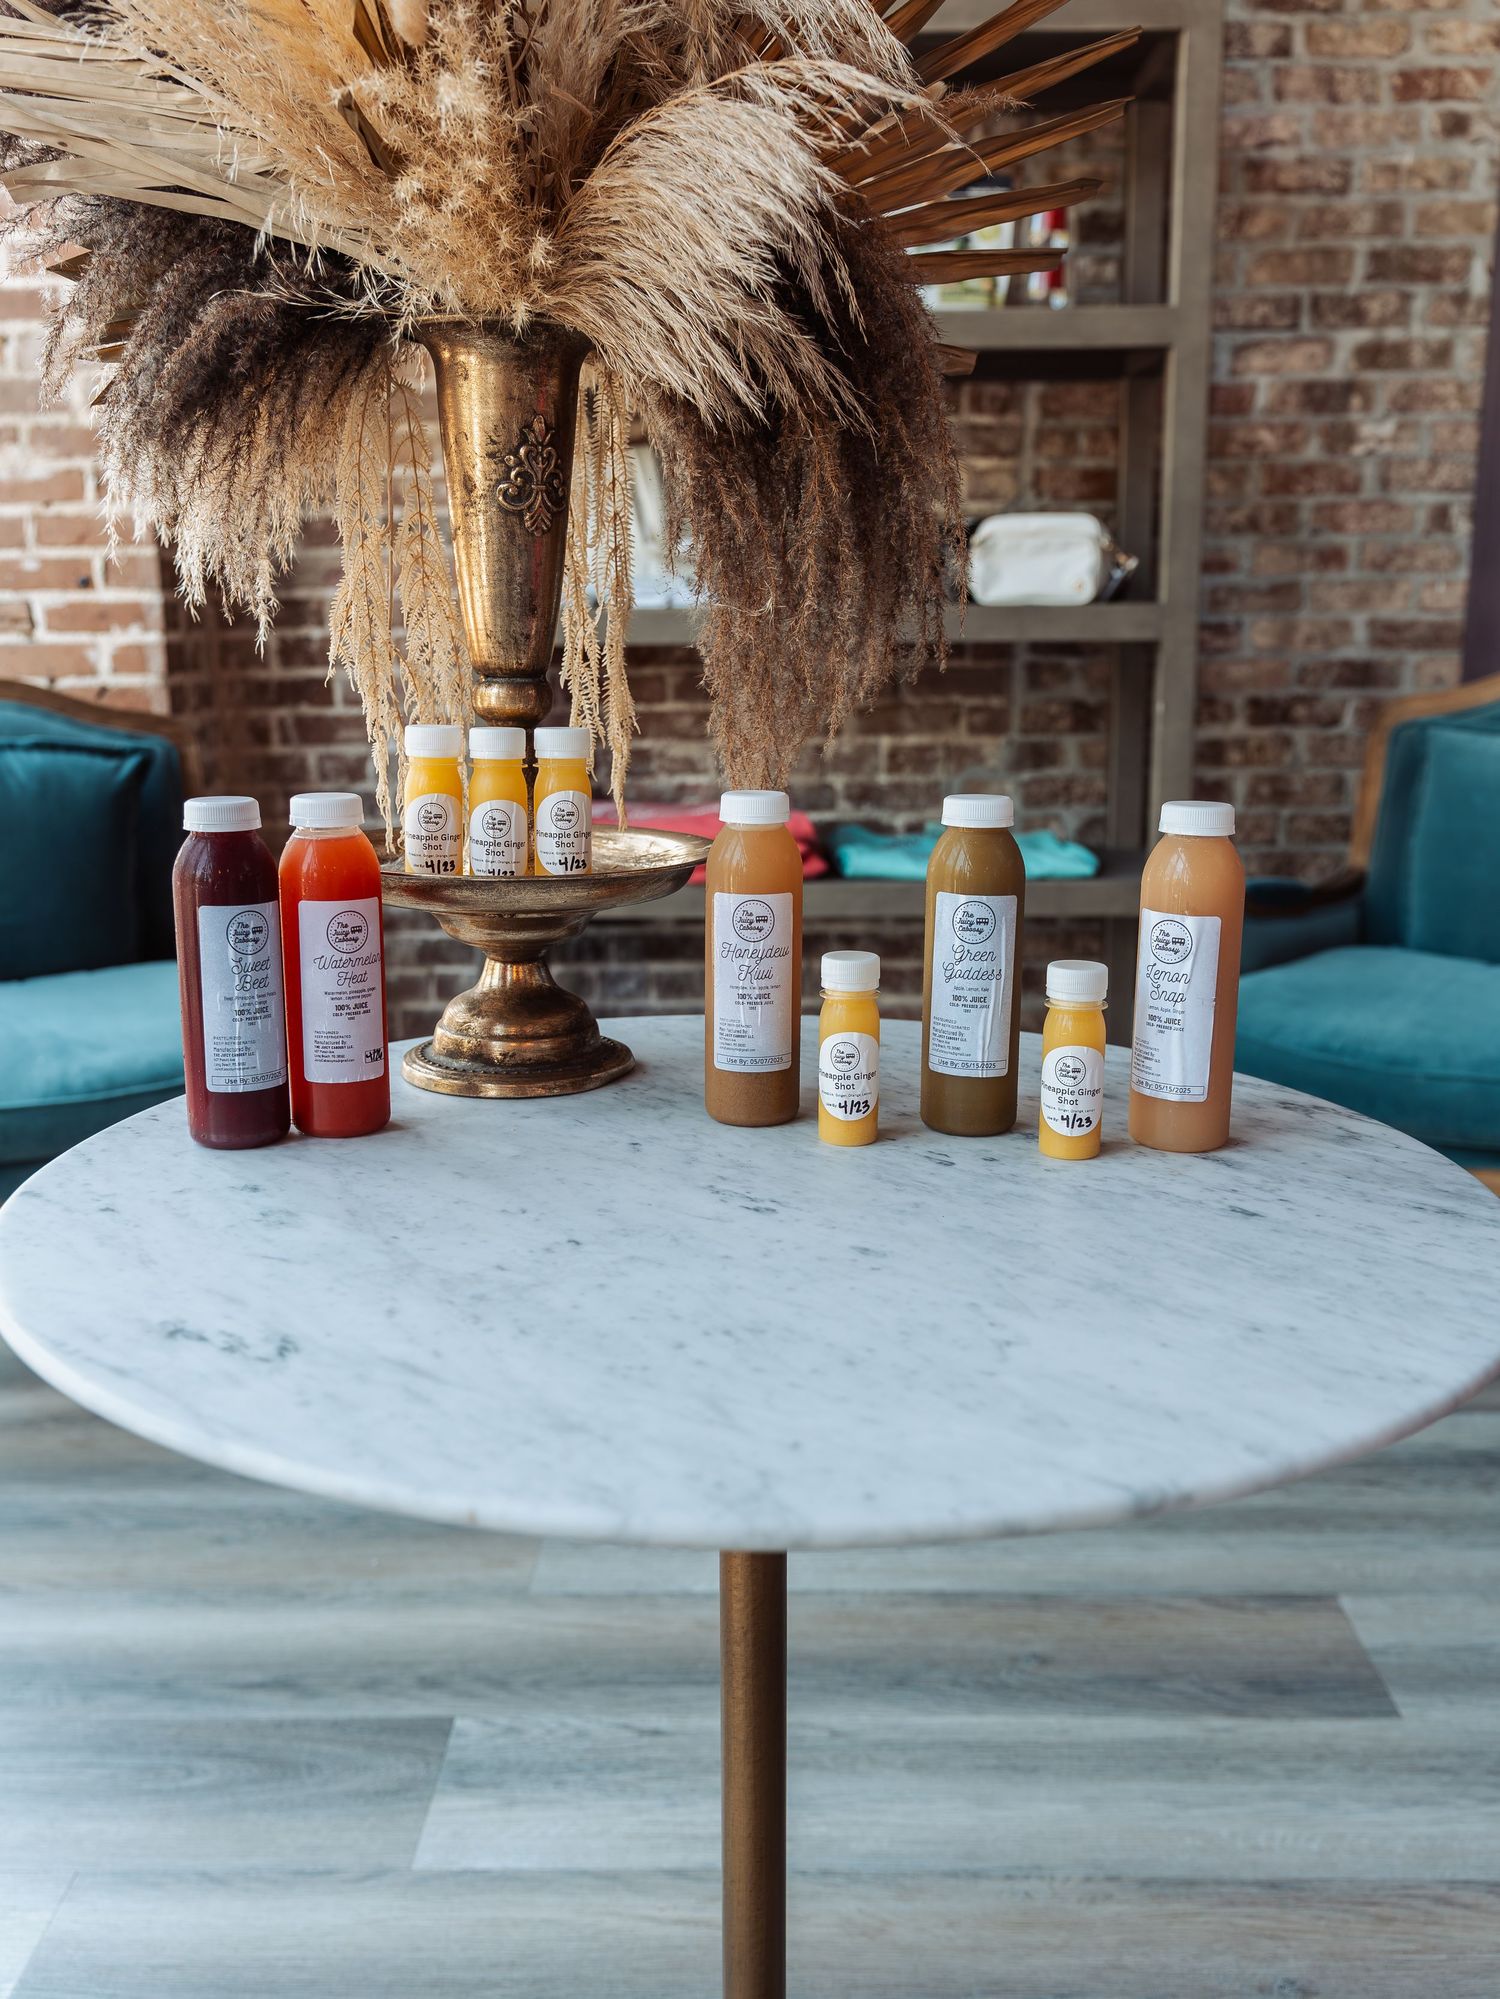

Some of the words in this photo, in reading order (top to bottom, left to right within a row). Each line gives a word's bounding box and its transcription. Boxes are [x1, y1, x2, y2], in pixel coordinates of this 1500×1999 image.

[559, 856, 586, 871] 4/23
[737, 917, 754, 925] Juicy
[957, 918, 975, 927] Juicy
[1154, 936, 1171, 946] Juicy
[721, 942, 789, 964] Honeydew
[952, 944, 996, 965] Green
[231, 956, 271, 975] Sweet
[942, 962, 1002, 983] Goddess
[337, 971, 368, 987] Heat
[738, 965, 773, 984] Kiwi
[1146, 963, 1190, 984] Lemon
[235, 974, 269, 991] Beet
[1150, 982, 1186, 1007] Snap
[253, 1006, 269, 1014] JUICE
[1148, 1014, 1162, 1023] 100%
[252, 1072, 281, 1082] 05/07/2025
[1155, 1084, 1191, 1093] 05/15/2025
[839, 1100, 870, 1114] 4/23
[1058, 1097, 1078, 1105] Shot
[1061, 1114, 1092, 1129] 4/23
